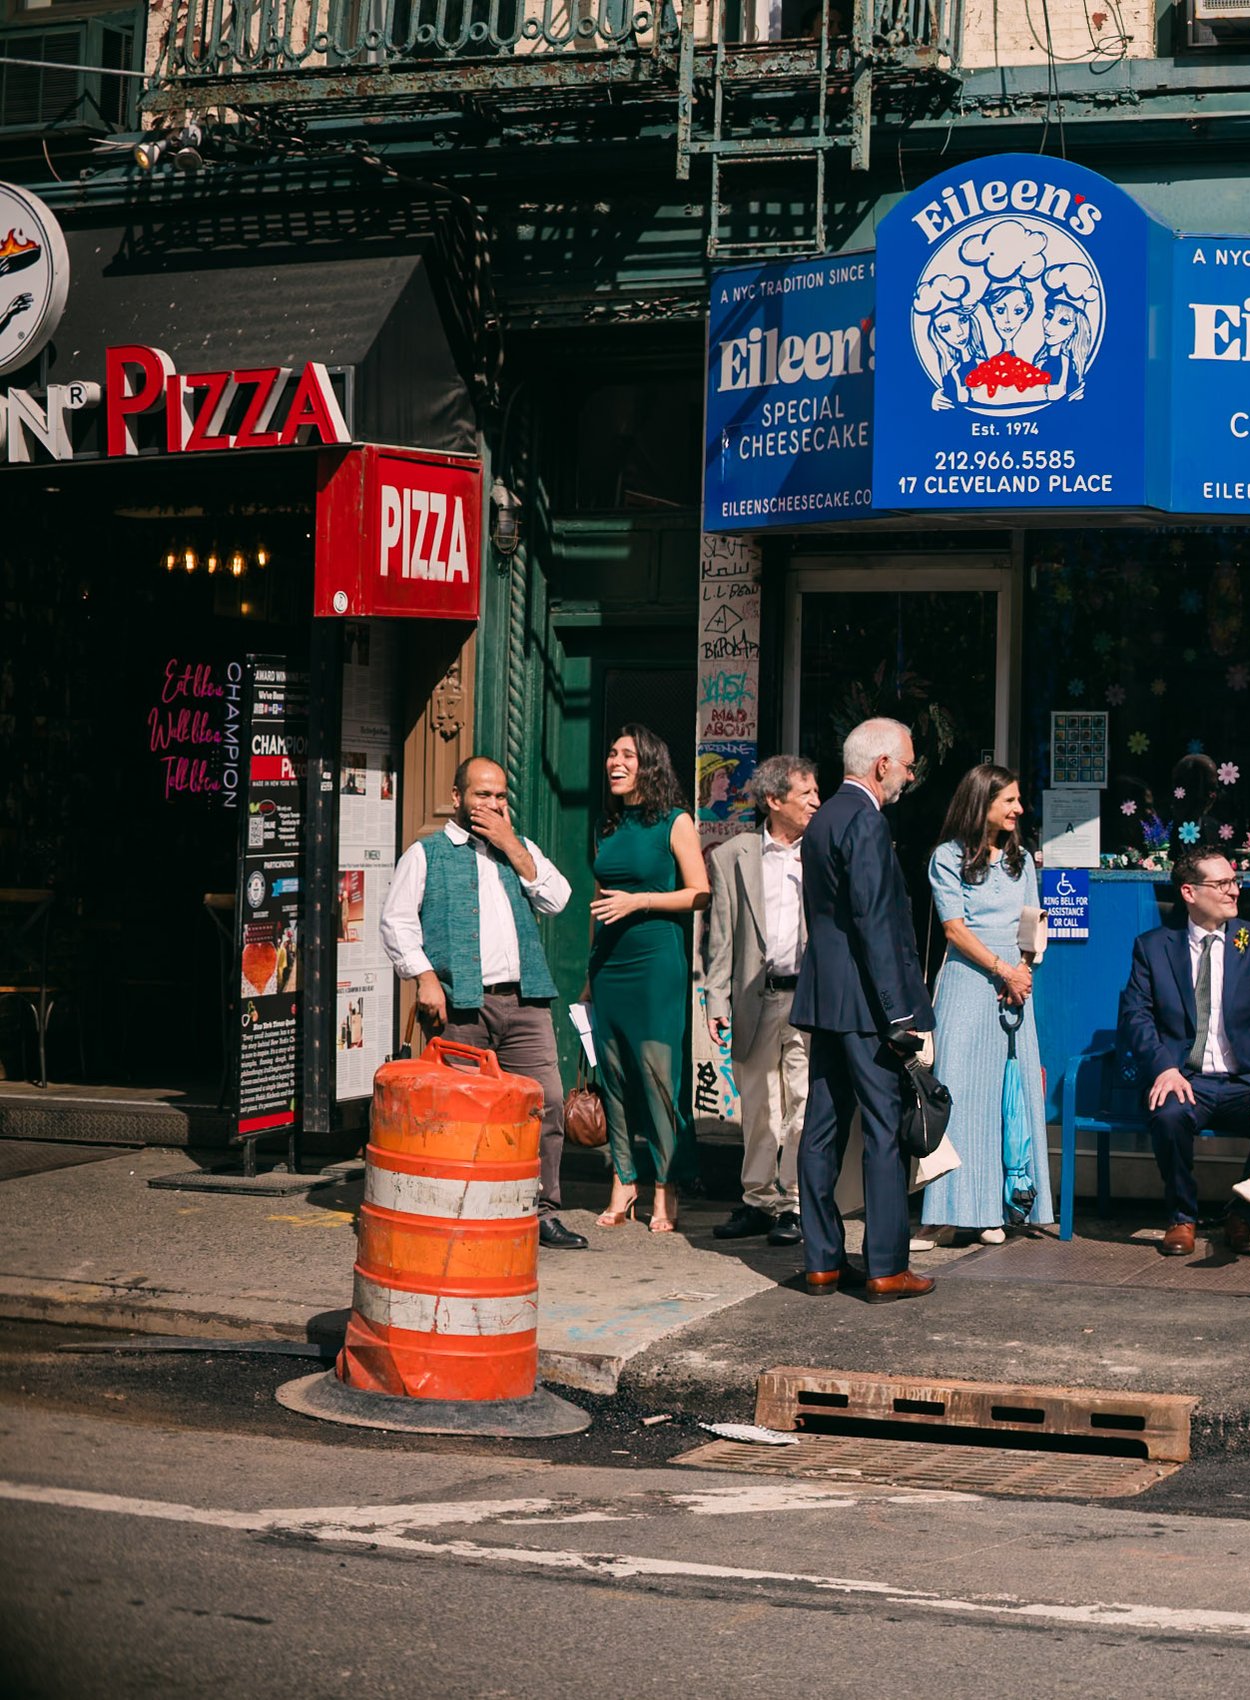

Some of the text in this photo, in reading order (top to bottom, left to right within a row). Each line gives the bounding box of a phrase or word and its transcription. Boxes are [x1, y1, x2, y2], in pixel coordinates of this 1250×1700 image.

[911, 179, 1103, 244] Eileen's
[1193, 248, 1206, 265] A
[721, 265, 864, 304] A NYC TRADITION SINCE
[716, 318, 876, 392] Eileen'
[106, 344, 353, 457] PIZZA
[761, 394, 845, 426] SPECIAL
[739, 422, 869, 460] CHEESECAKE
[971, 423, 1039, 436] Est. 1974
[935, 450, 1076, 470] 212.966.5585
[898, 474, 1113, 494] 17 CLEVELAND PLACE
[721, 491, 872, 518] EILEENSCHEESECAKE.CO
[380, 485, 470, 584] PIZZA
[223, 662, 242, 808] CHAMPION
[704, 722, 755, 737] ABOUT
[1065, 823, 1074, 833] A
[1044, 897, 1088, 905] RING BELL FOR
[1048, 908, 1084, 916] ASSISTANCE
[1054, 918, 1078, 927] OR CALL
